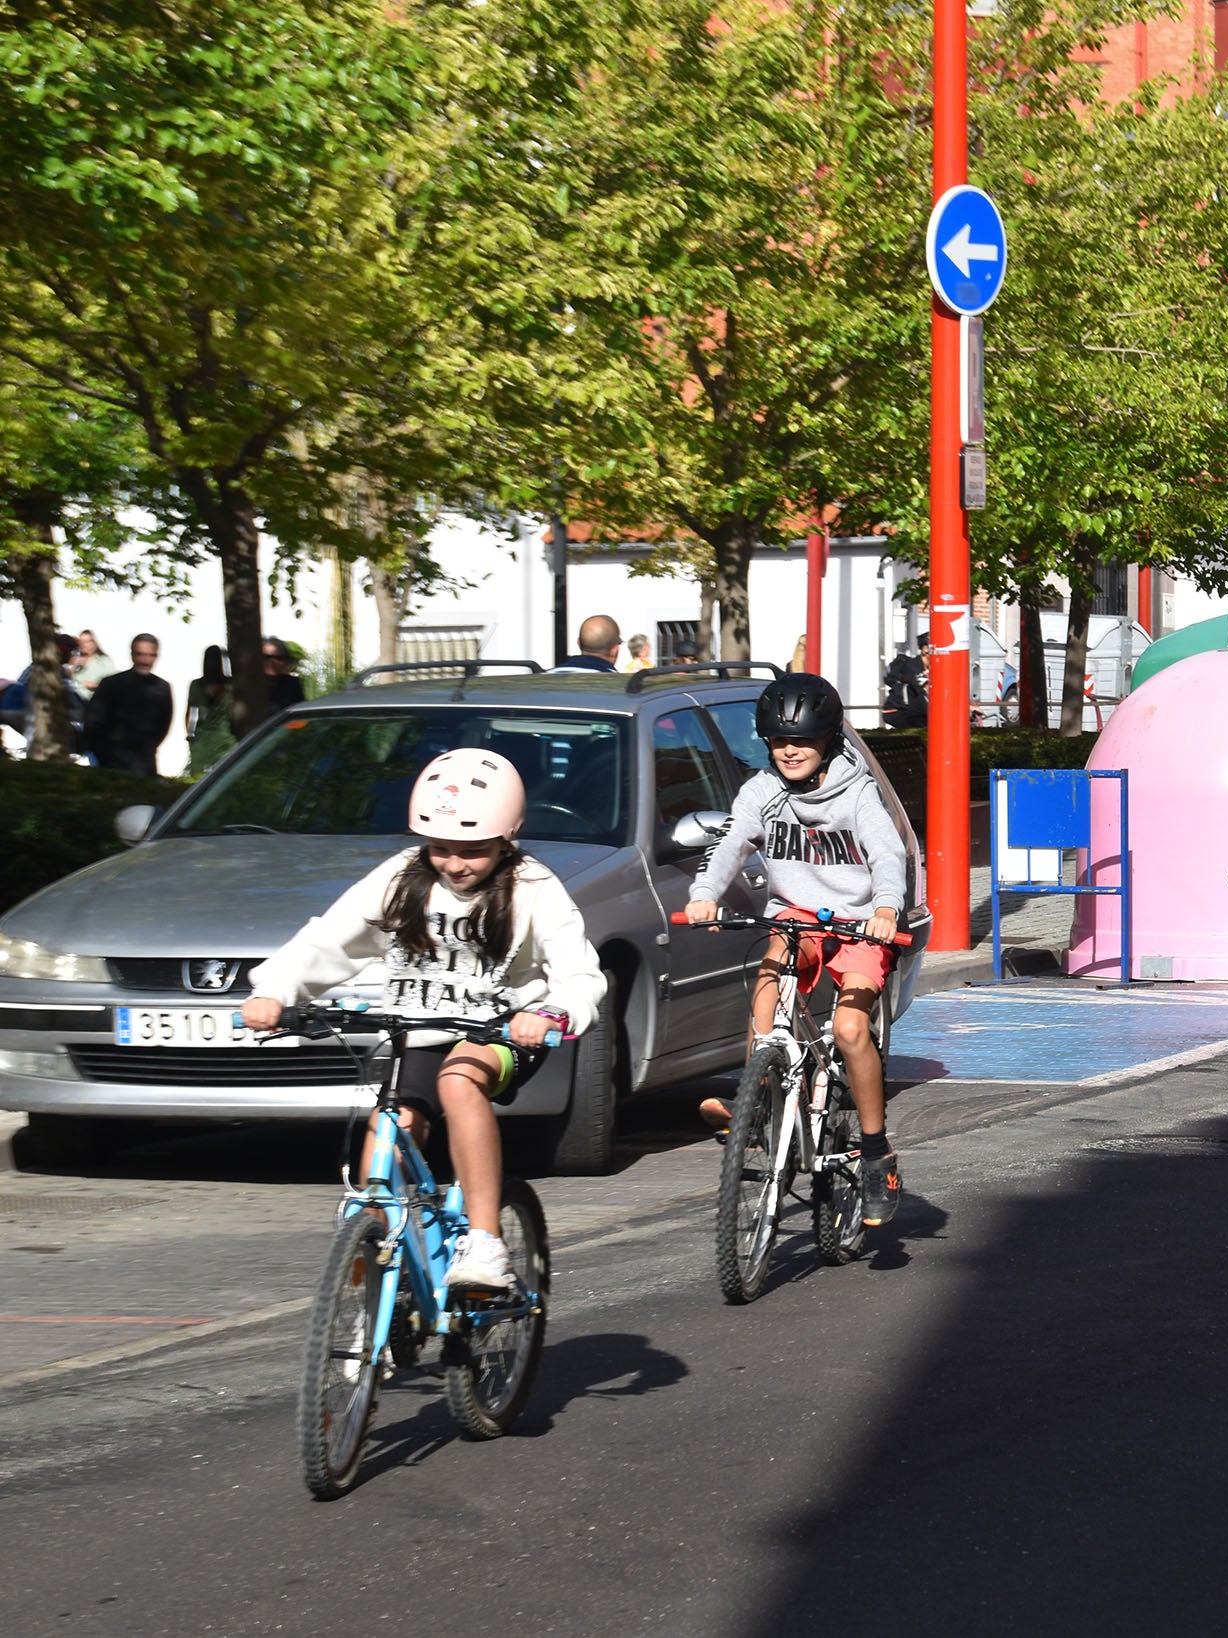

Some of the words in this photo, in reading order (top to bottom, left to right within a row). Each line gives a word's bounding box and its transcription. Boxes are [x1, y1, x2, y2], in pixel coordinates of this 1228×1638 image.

[766, 820, 776, 859] THE
[772, 821, 864, 865] BATMAN
[140, 1013, 217, 1040] 3510
